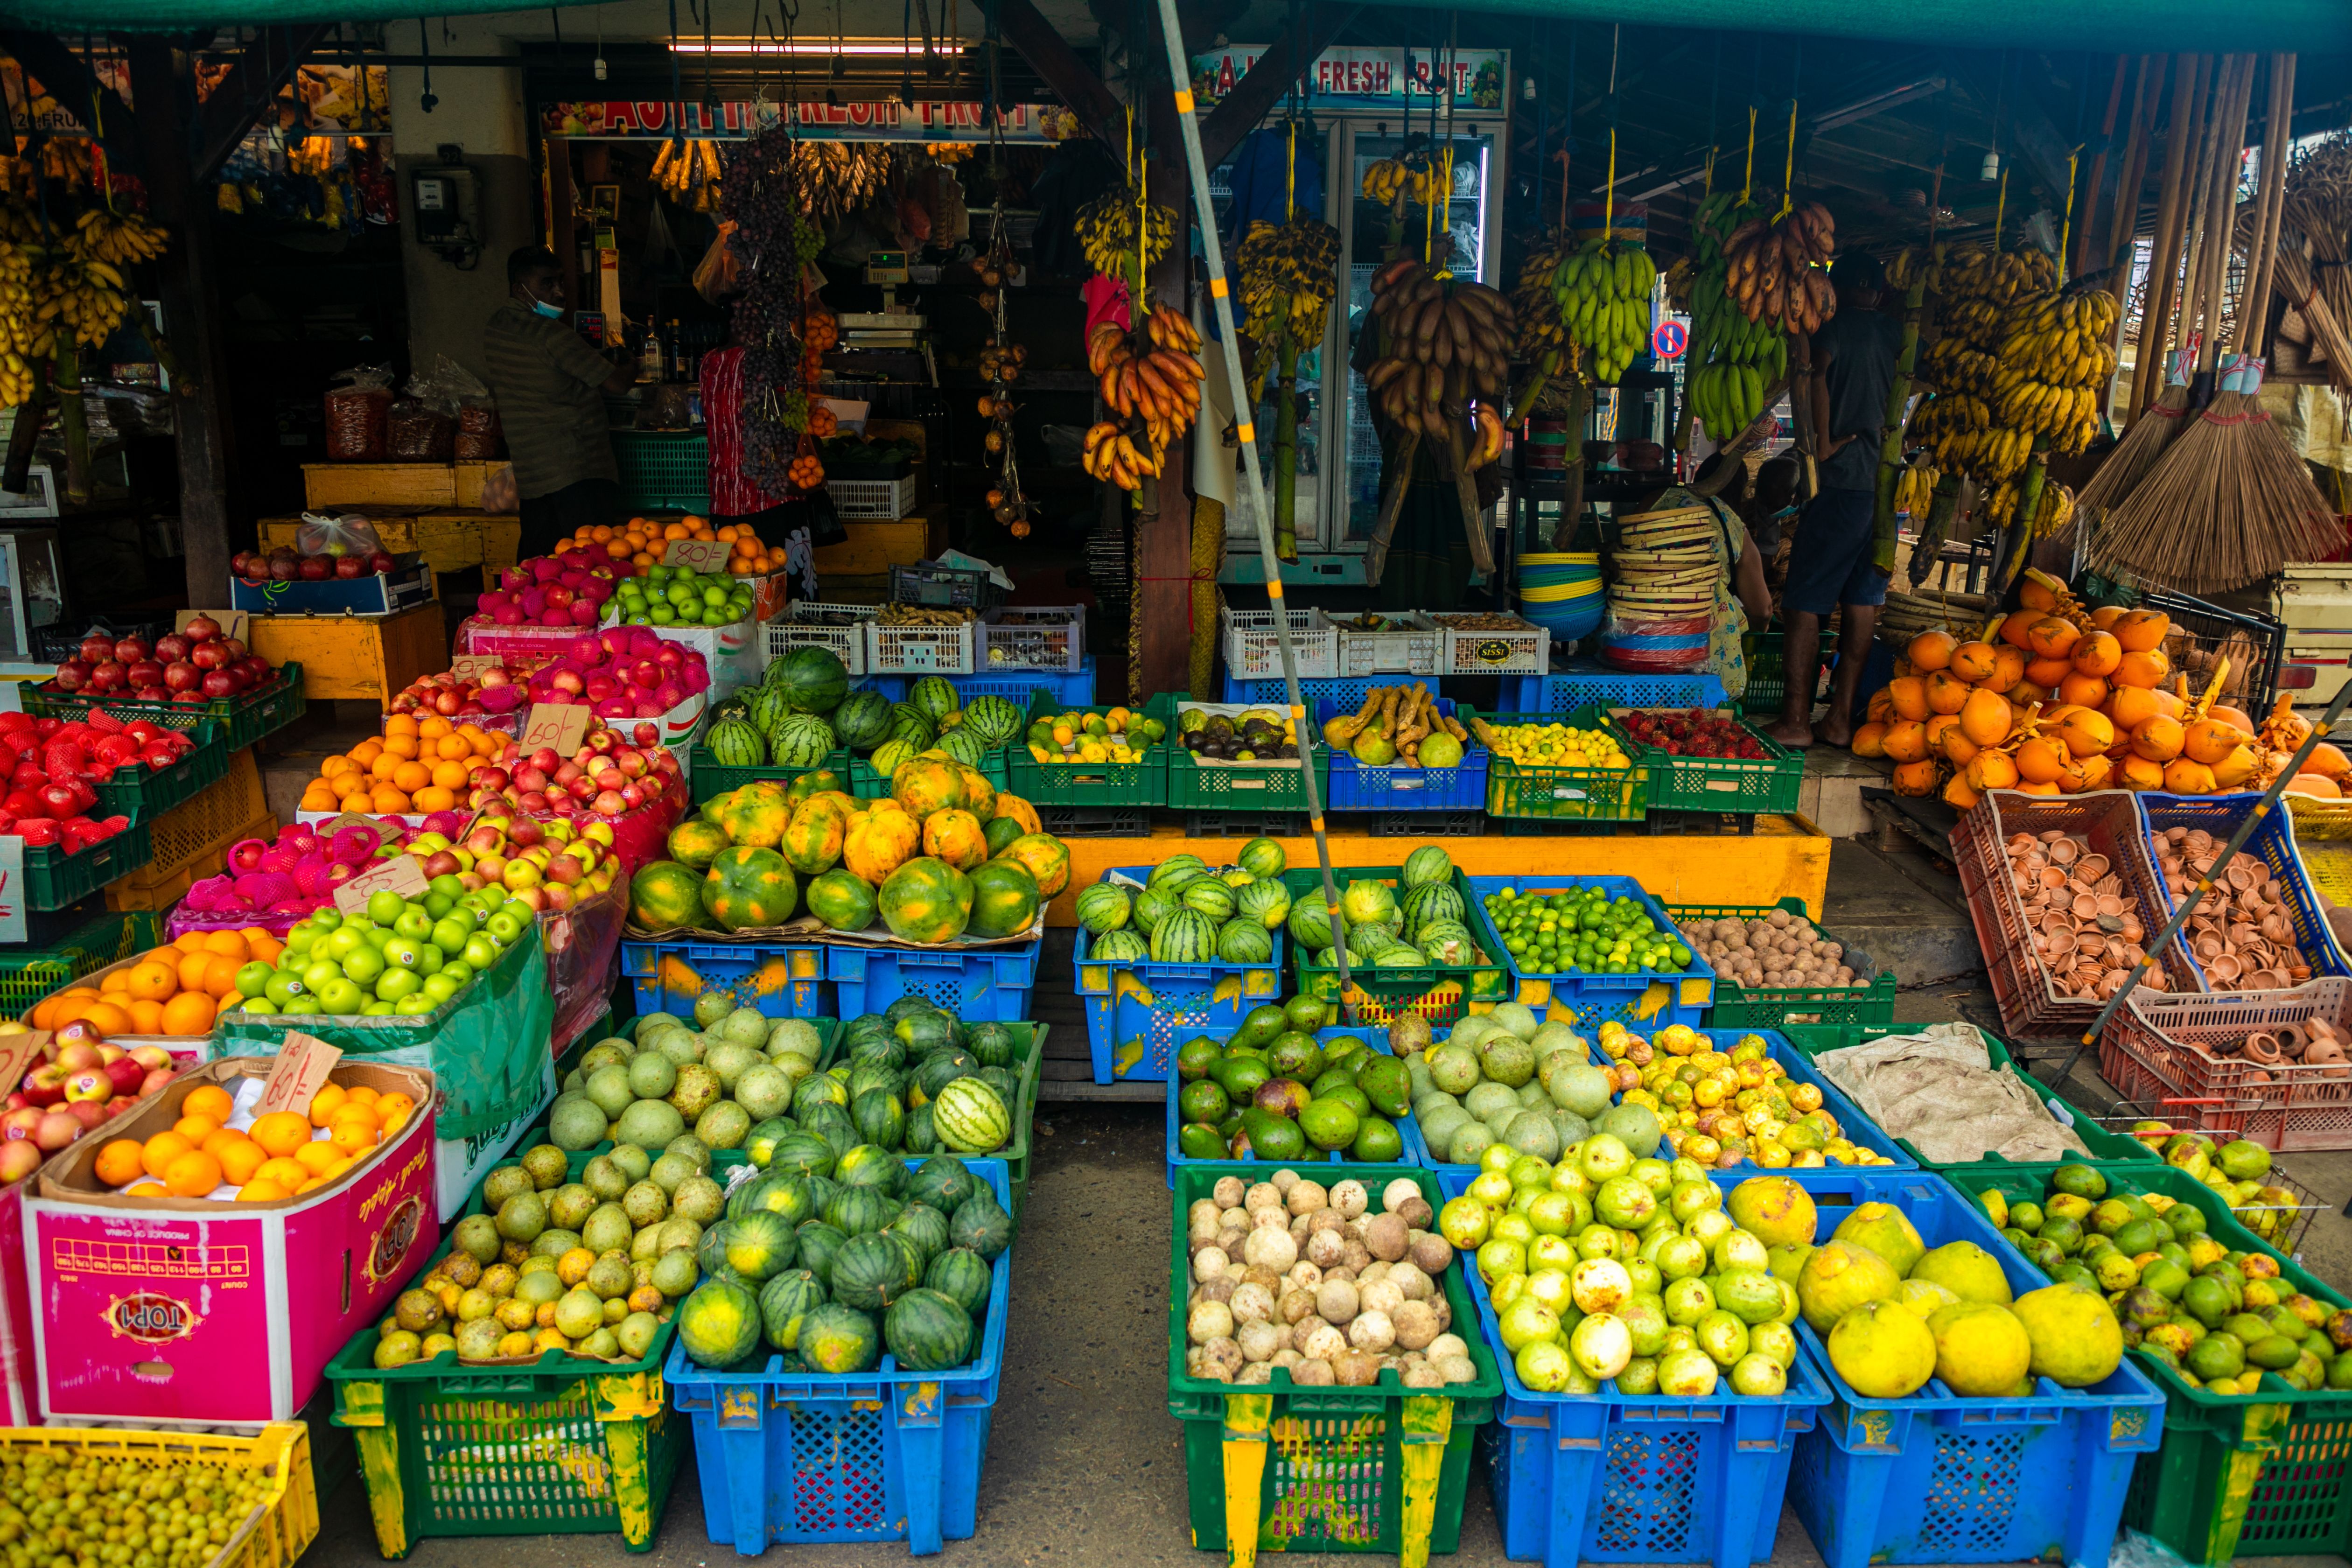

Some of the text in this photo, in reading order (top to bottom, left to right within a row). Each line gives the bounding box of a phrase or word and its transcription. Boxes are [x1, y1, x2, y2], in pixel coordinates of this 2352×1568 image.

[1318, 61, 1392, 95] FRESH
[1402, 62, 1468, 95] FRT
[675, 541, 722, 573] 80/=
[105, 1228, 133, 1238] CHINA
[147, 1230, 190, 1240] PRODUCE
[378, 1205, 418, 1270] TOP1
[220, 1281, 248, 1289] COUNT
[120, 1303, 183, 1330] TOP1
